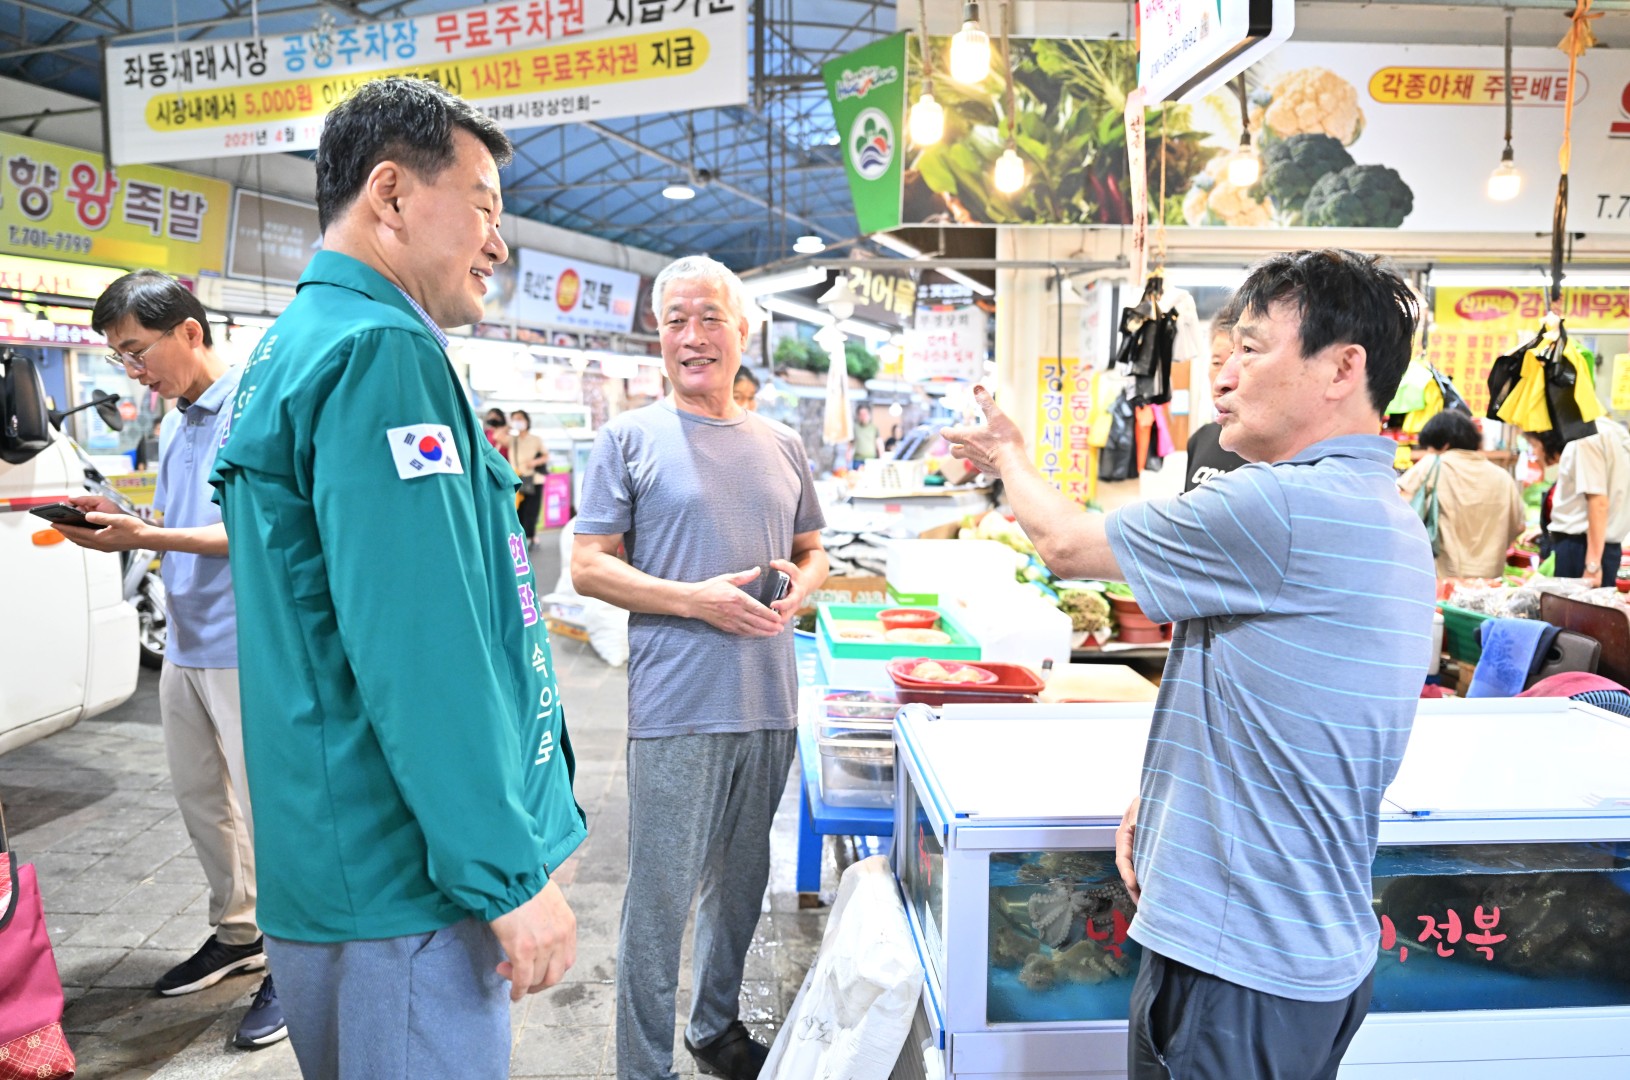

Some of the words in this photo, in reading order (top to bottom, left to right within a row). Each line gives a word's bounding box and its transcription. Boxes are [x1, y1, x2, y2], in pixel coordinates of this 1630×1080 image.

[123, 39, 268, 90] 좌동재래시장
[434, 0, 585, 53] 무료주차권
[155, 93, 237, 126] 시장내에서
[244, 84, 313, 117] 5,000원
[472, 61, 521, 92] 1시간
[532, 43, 639, 86] 무료주차권
[651, 36, 694, 69] 지급
[1382, 73, 1475, 101] 각종야채
[224, 130, 267, 148] 2021년
[582, 278, 614, 314] 전복
[1417, 905, 1508, 961] 전복
